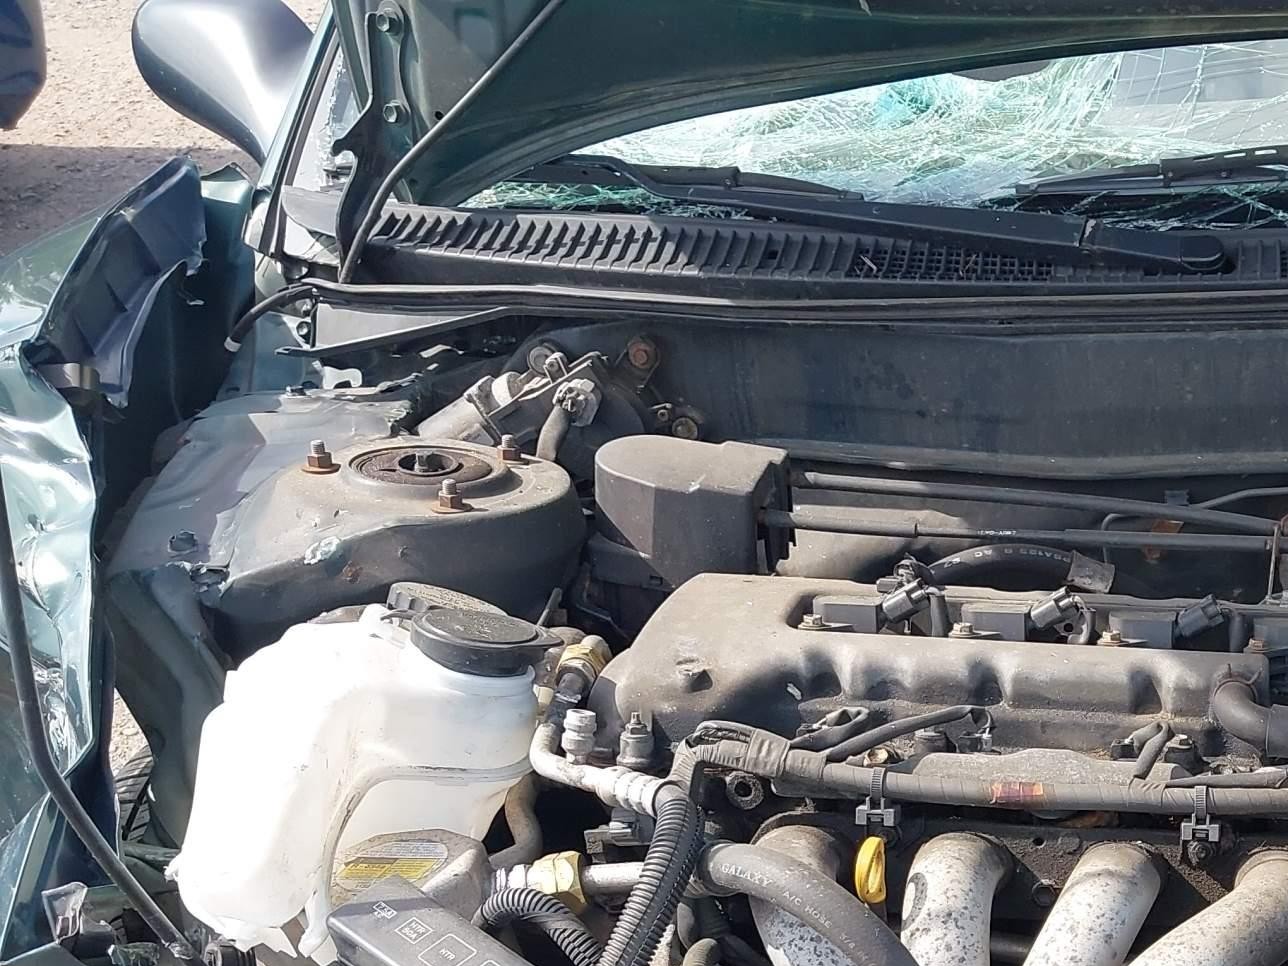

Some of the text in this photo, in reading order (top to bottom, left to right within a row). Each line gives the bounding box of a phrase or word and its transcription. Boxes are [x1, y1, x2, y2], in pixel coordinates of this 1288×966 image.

[721, 863, 773, 887] GALAXY
[805, 905, 833, 929] HOSE
[439, 947, 456, 961] HTR
